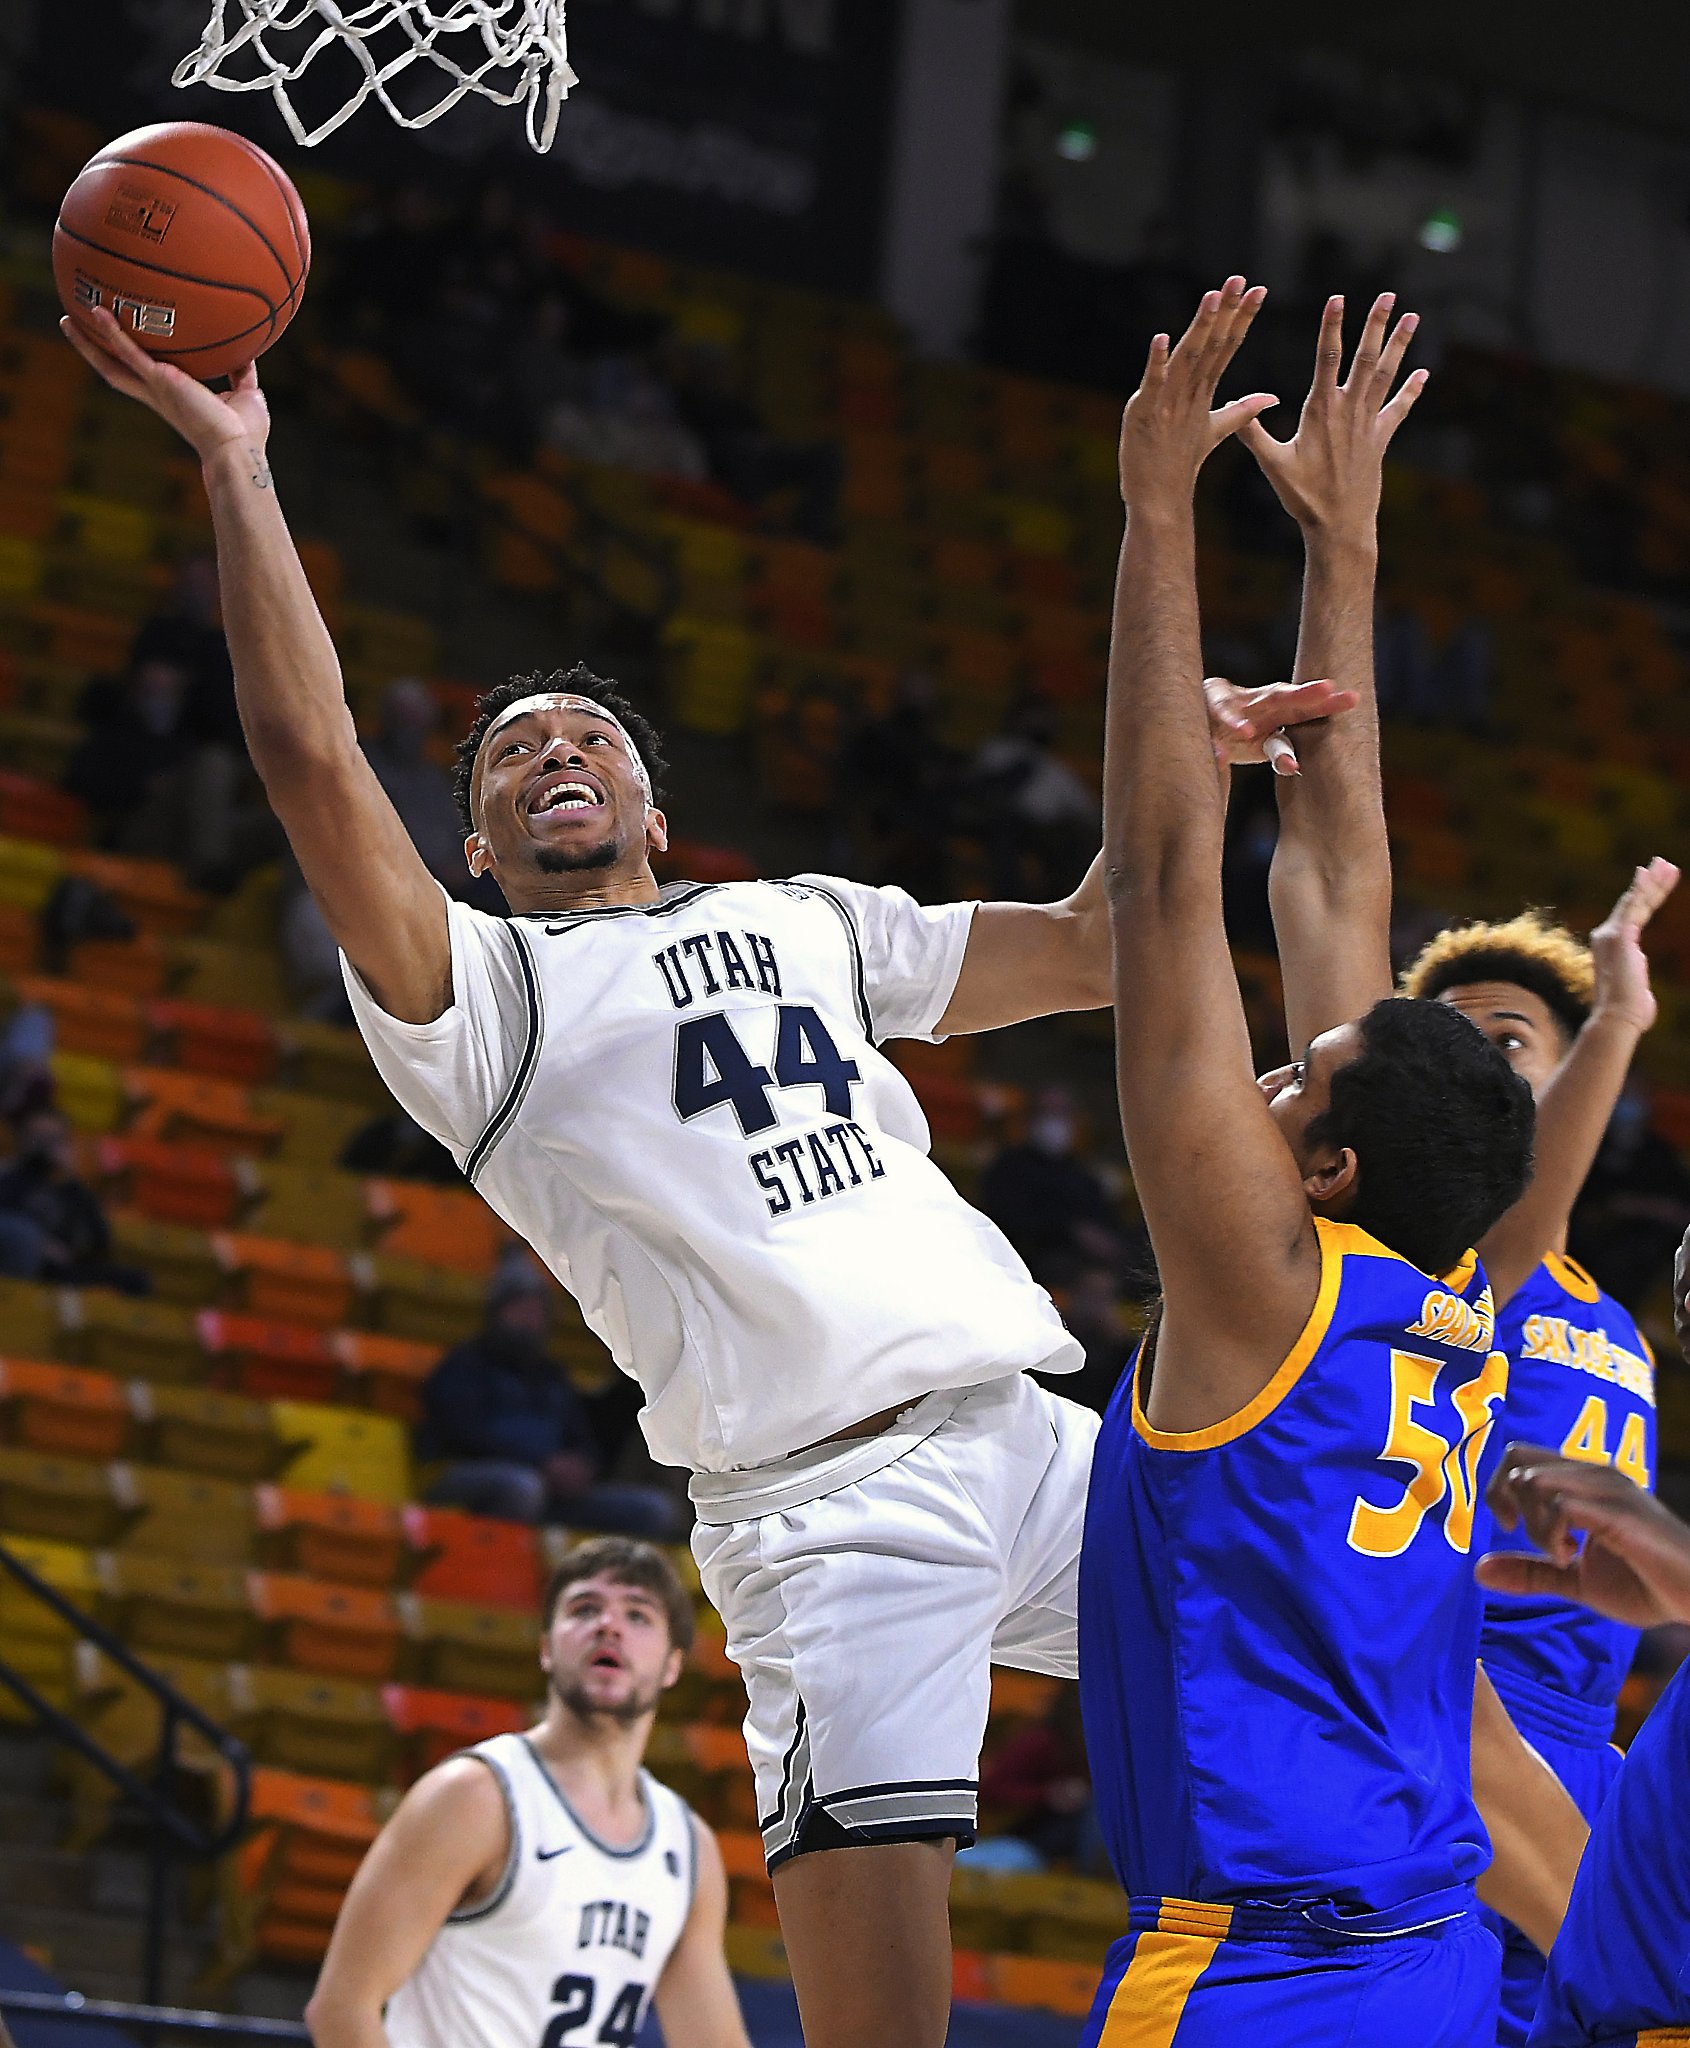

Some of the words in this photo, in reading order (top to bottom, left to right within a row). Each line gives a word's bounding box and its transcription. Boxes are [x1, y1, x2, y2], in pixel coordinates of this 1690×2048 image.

[652, 929, 783, 1010] UTAH
[671, 1003, 864, 1139] 44
[748, 1122, 887, 1218] STATE
[1520, 1314, 1571, 1367] SAN
[1346, 1348, 1510, 1558] 50
[1560, 1395, 1649, 1488] 44
[577, 1900, 650, 1960] UTAH
[541, 1972, 646, 2048] 24
